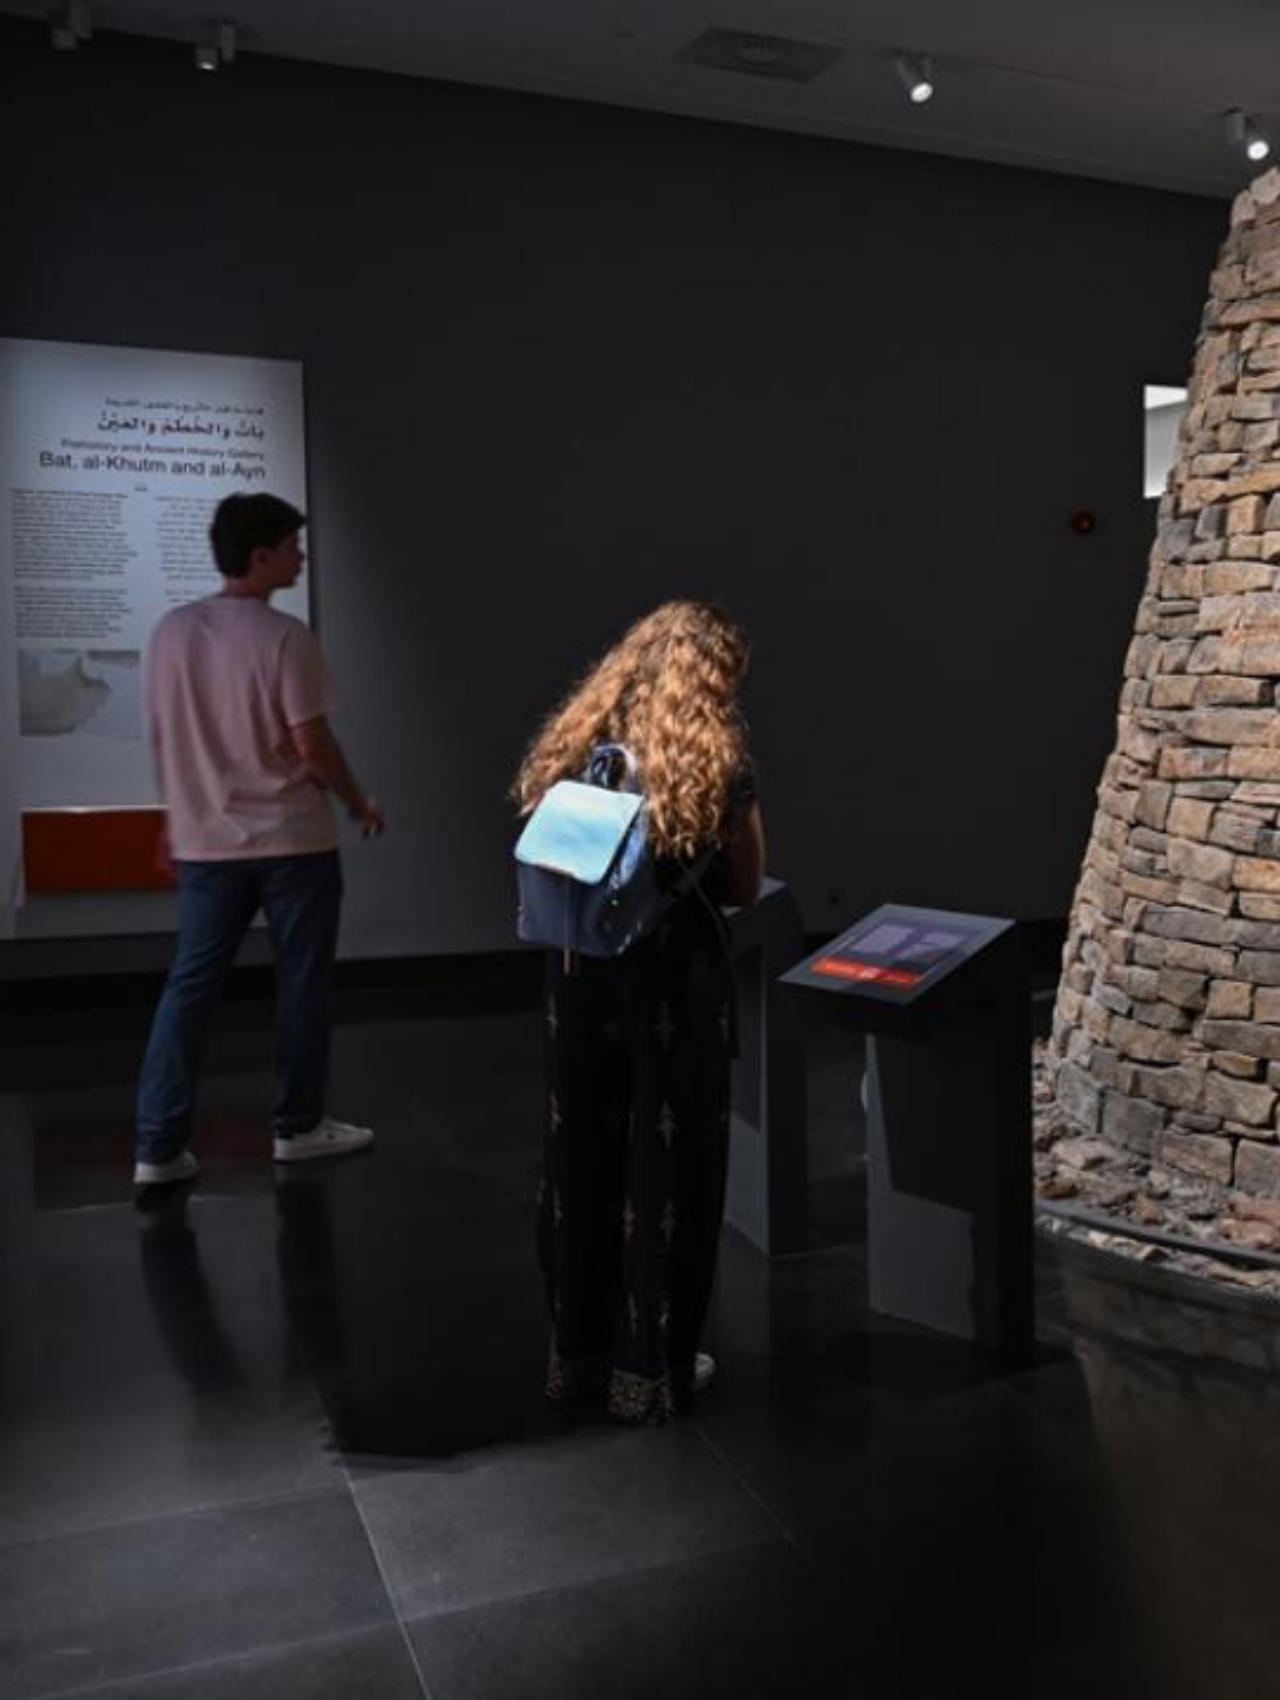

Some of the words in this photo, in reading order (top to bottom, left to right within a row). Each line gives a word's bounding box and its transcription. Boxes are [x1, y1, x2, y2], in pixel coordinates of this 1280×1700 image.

[39, 451, 78, 469] Bat,
[83, 454, 167, 472] al-Khutm
[171, 458, 205, 475] and
[210, 461, 266, 480] al-Ayn
